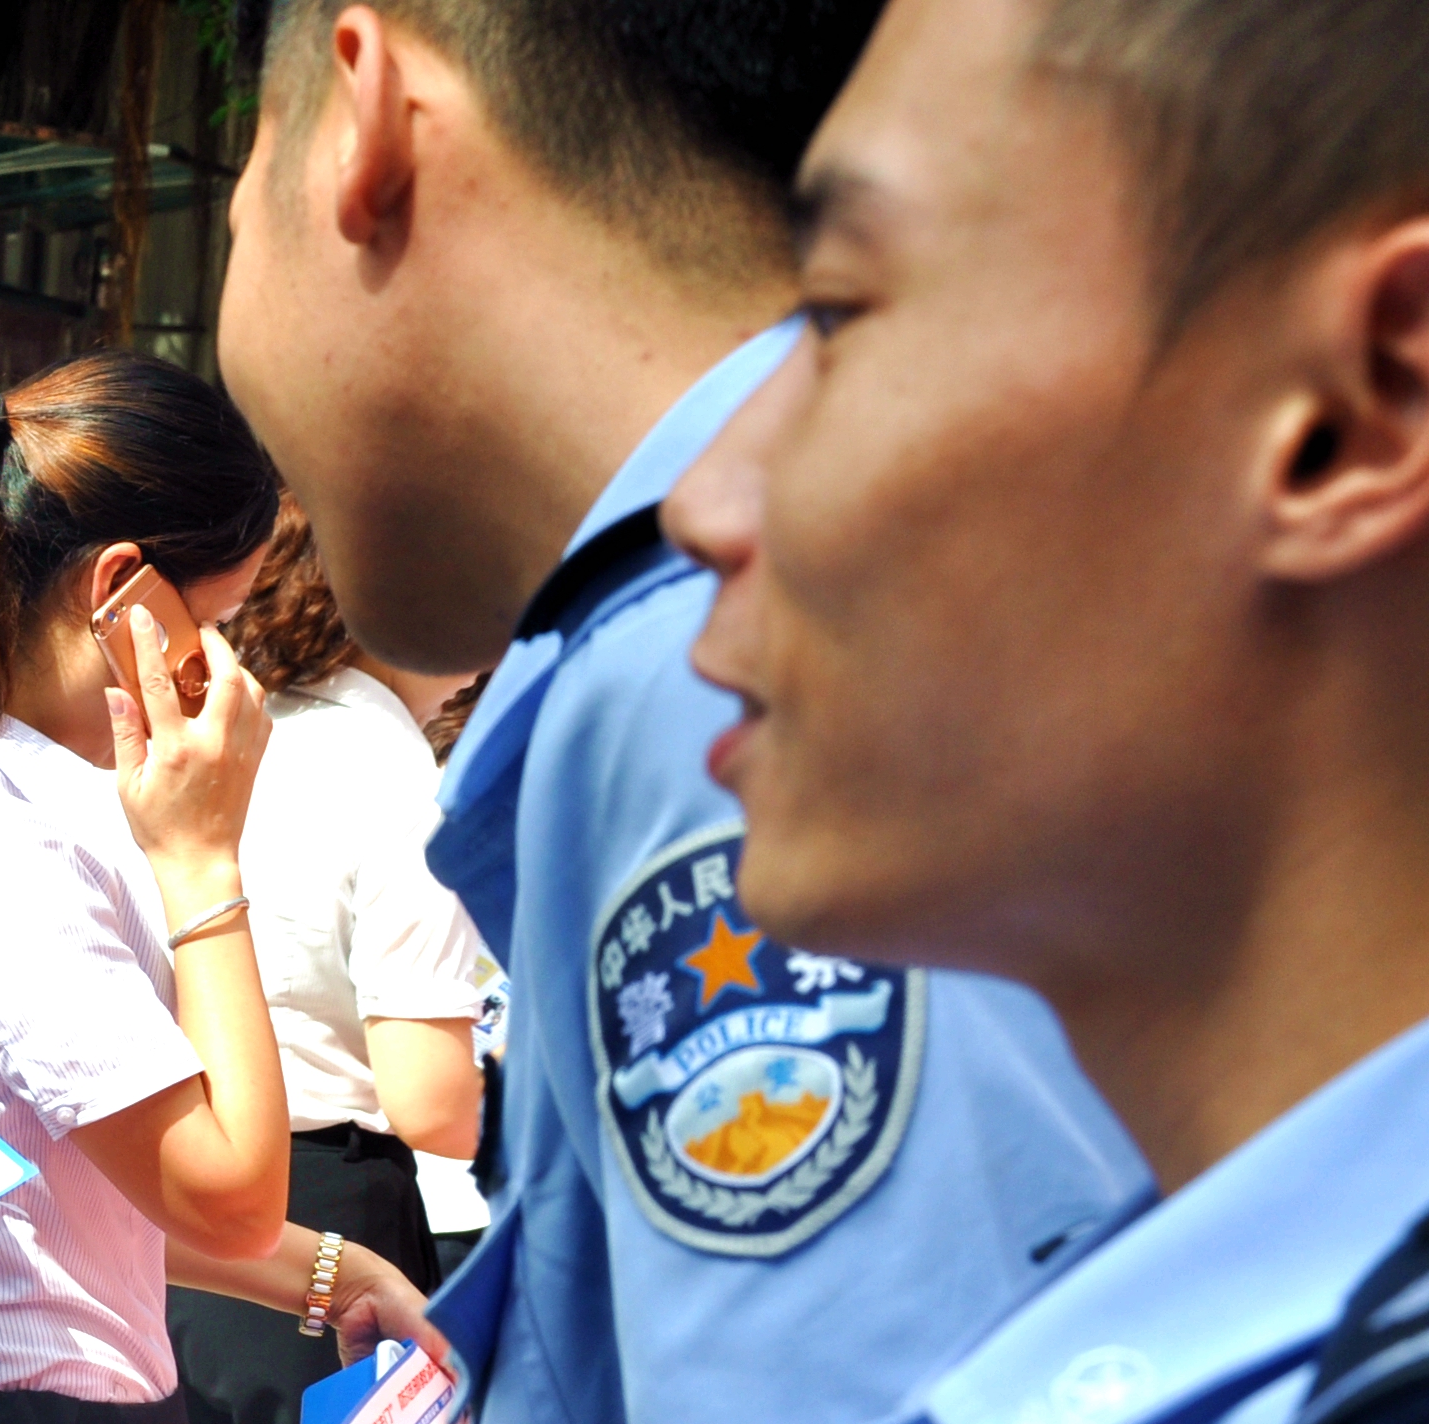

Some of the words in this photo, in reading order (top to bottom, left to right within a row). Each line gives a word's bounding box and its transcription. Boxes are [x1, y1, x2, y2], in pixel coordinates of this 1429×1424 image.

[599, 852, 736, 990] 中华人民
[675, 1008, 805, 1073] POLICE
